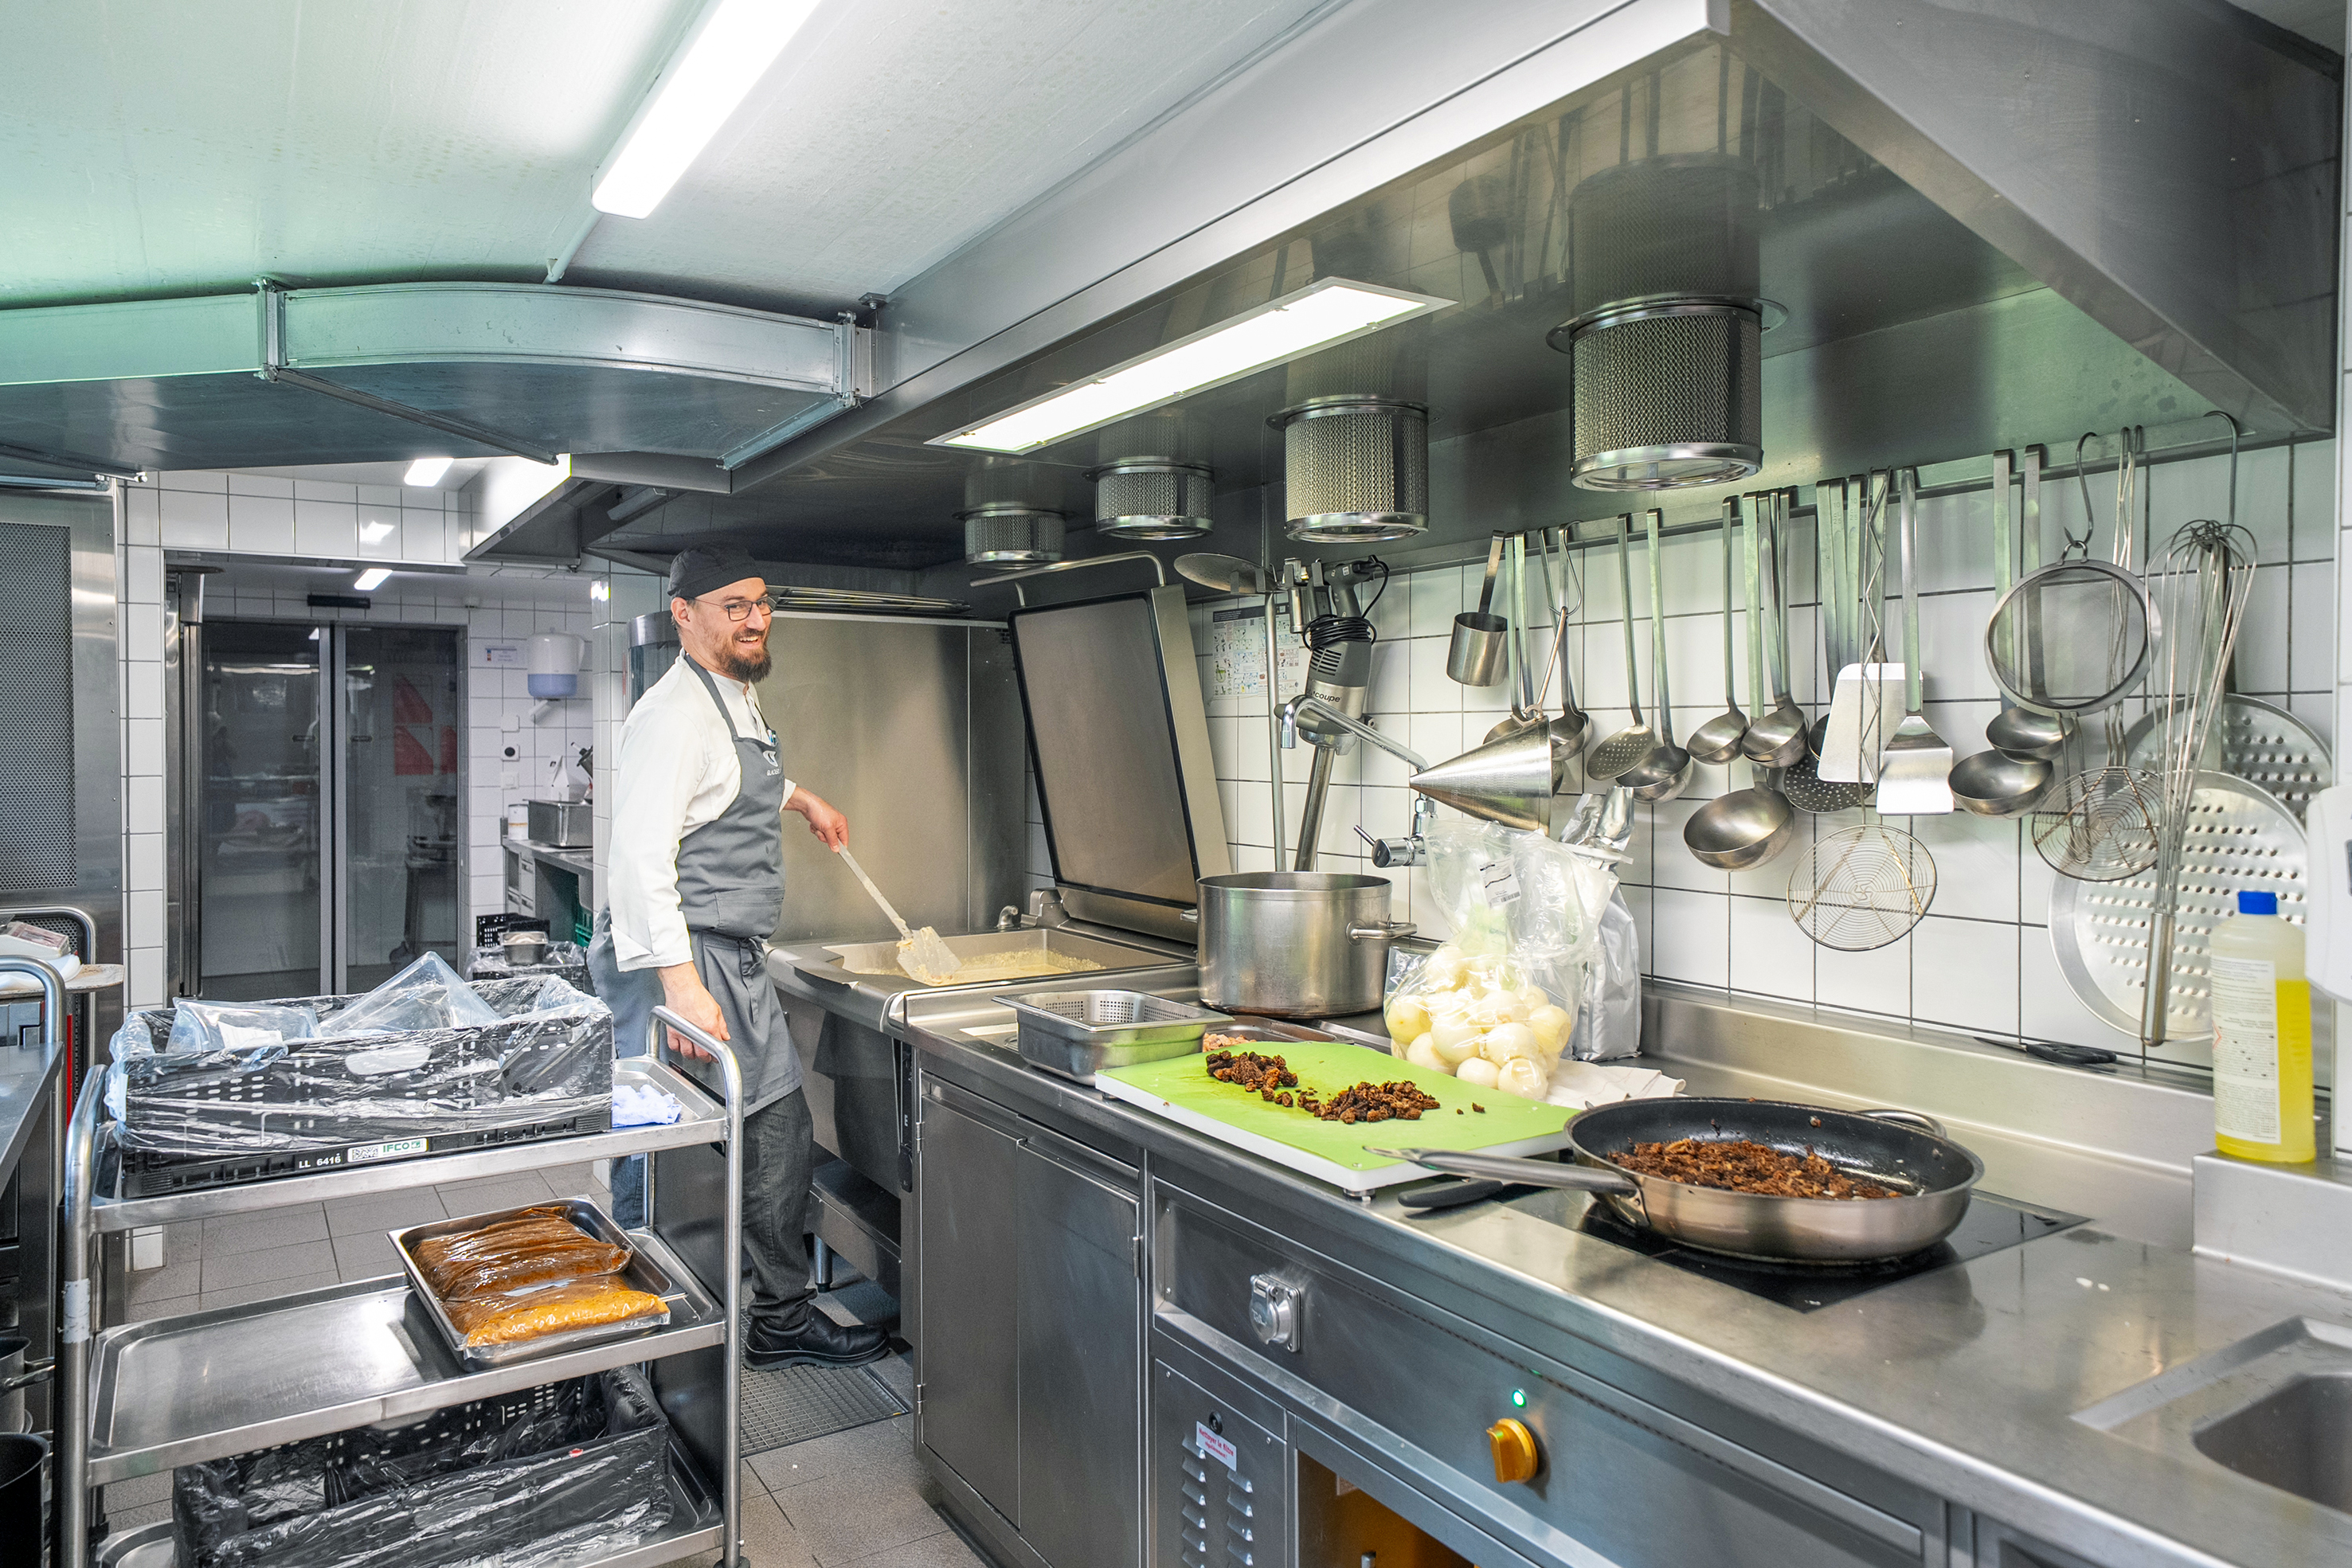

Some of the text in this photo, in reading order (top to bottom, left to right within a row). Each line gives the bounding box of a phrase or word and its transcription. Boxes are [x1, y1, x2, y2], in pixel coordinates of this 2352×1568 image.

[383, 1142, 410, 1153] IFCO
[299, 1155, 342, 1169] LL 6416
